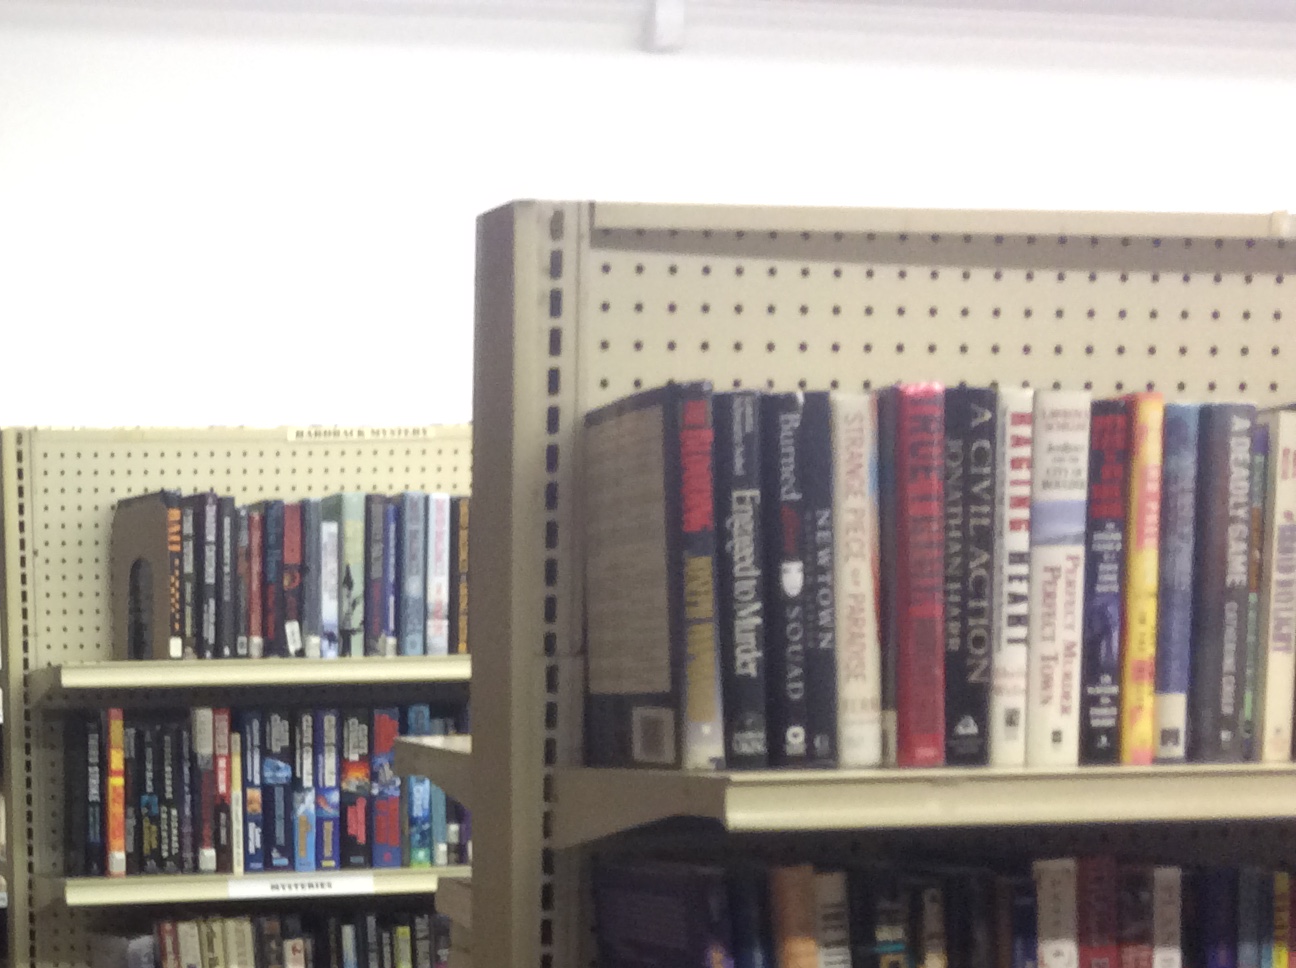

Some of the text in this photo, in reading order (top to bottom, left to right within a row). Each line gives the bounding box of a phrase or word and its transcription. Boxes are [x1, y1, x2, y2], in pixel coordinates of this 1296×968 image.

[843, 413, 866, 499] STRANGE
[728, 488, 761, 576] Engaged
[844, 508, 868, 563] PIECE
[967, 403, 992, 684] A CIVIL ACTION
[817, 509, 834, 649] NEWTOWN
